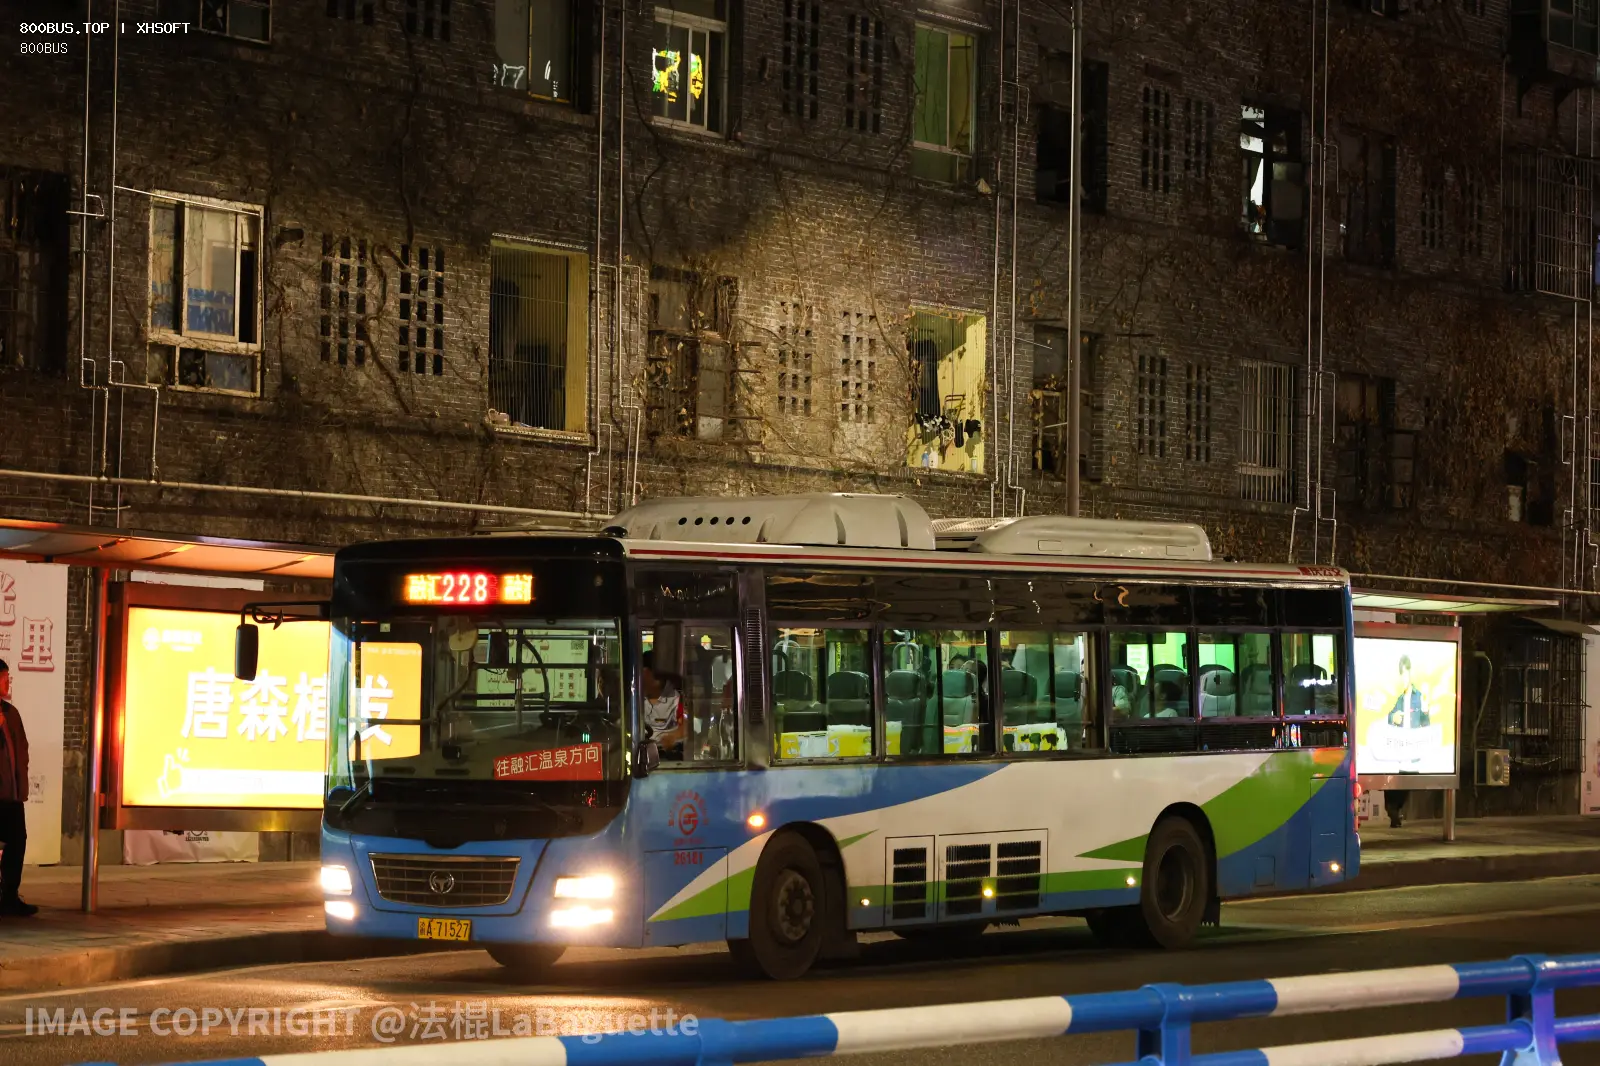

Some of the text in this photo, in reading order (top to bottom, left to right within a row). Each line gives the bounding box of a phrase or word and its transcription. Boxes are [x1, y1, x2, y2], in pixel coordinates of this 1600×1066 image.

[442, 573, 488, 602] 228
[180, 666, 395, 746] 唐森植发
[496, 744, 600, 778] 往融汇温泉方向
